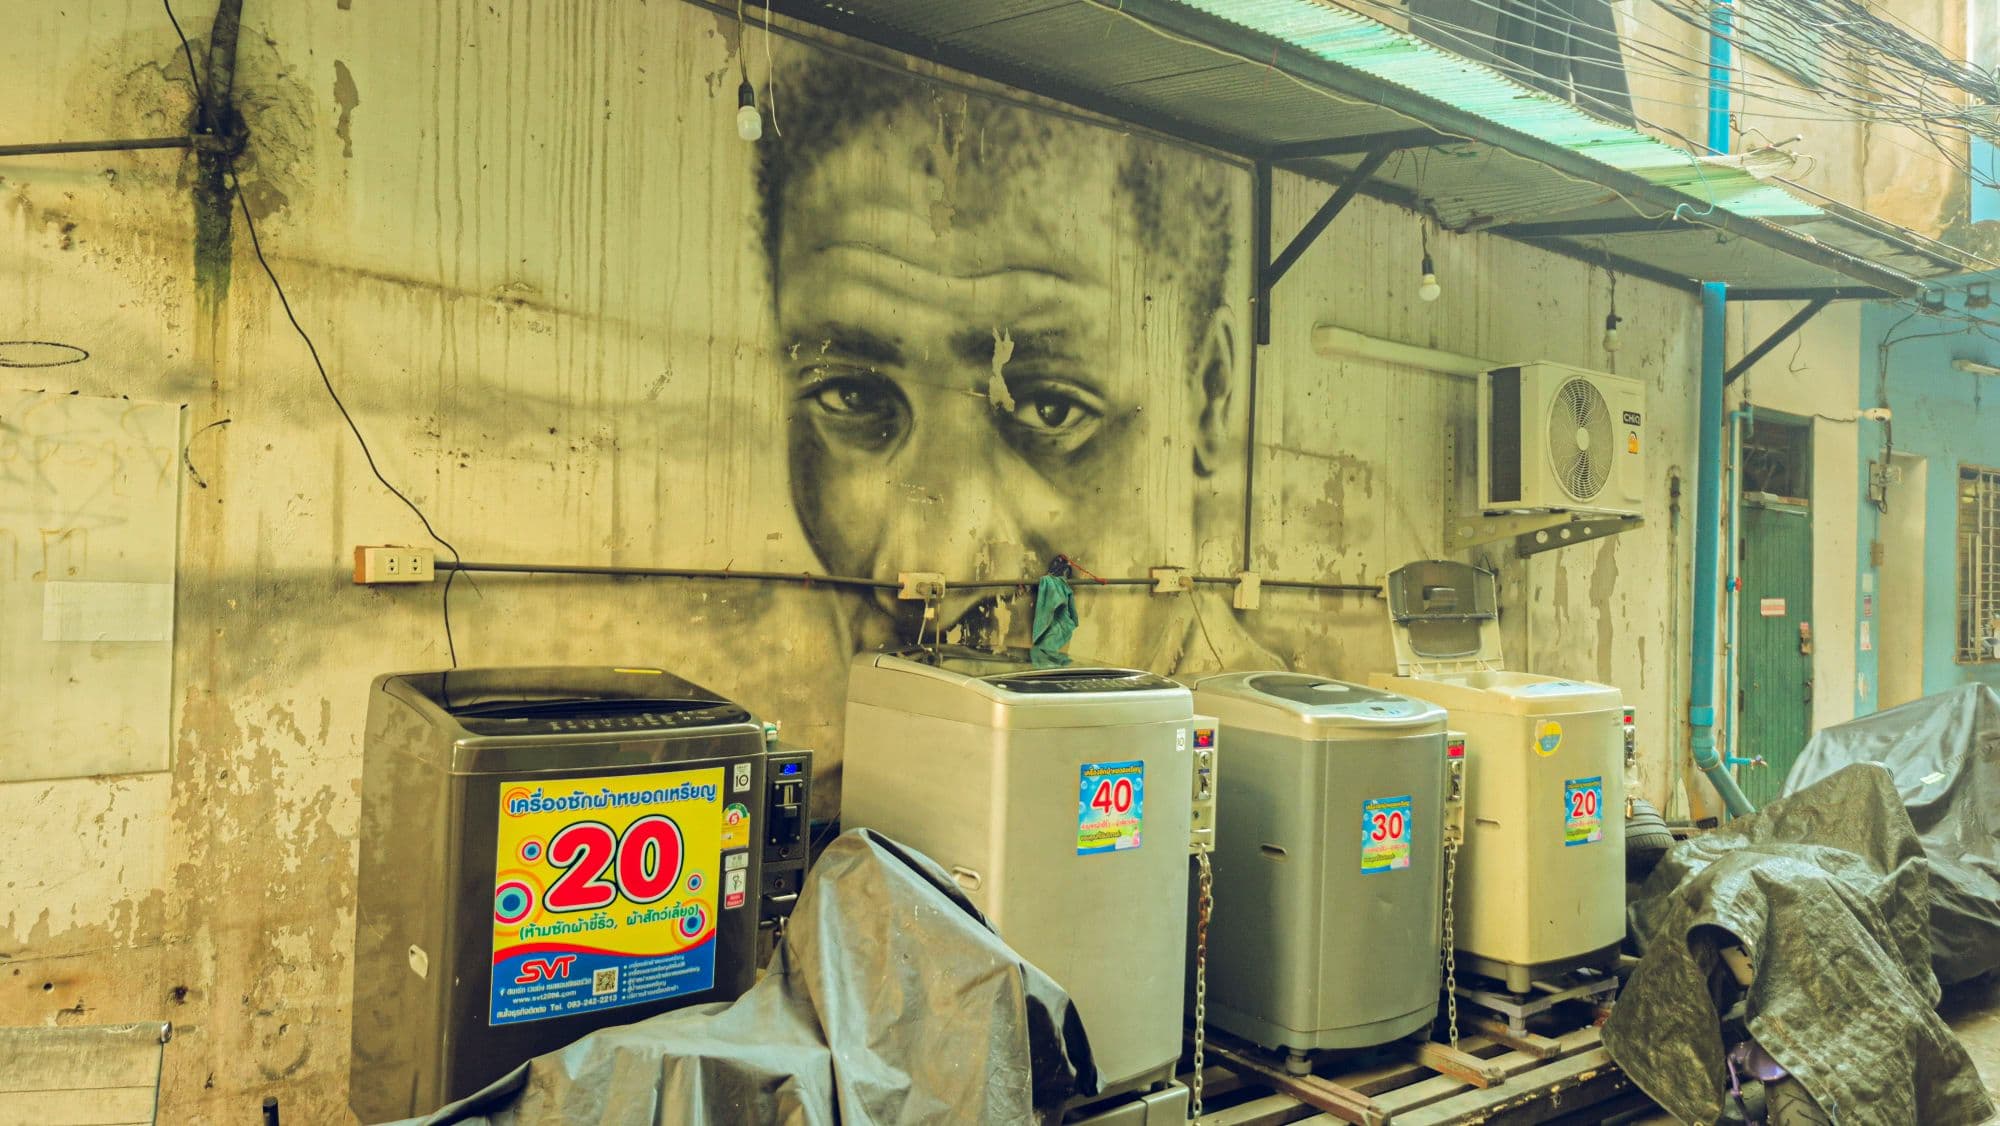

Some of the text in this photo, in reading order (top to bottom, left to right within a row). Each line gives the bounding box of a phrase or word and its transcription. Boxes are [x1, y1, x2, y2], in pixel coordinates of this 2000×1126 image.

[510, 782, 716, 815] เครื่องซักผ้าหยอดเหรียญ
[1091, 778, 1133, 814] 40
[1572, 790, 1596, 818] 20
[1371, 811, 1404, 841] 30
[544, 815, 683, 912] 20
[515, 954, 577, 984] SVT
[550, 1003, 564, 1012] Tel.
